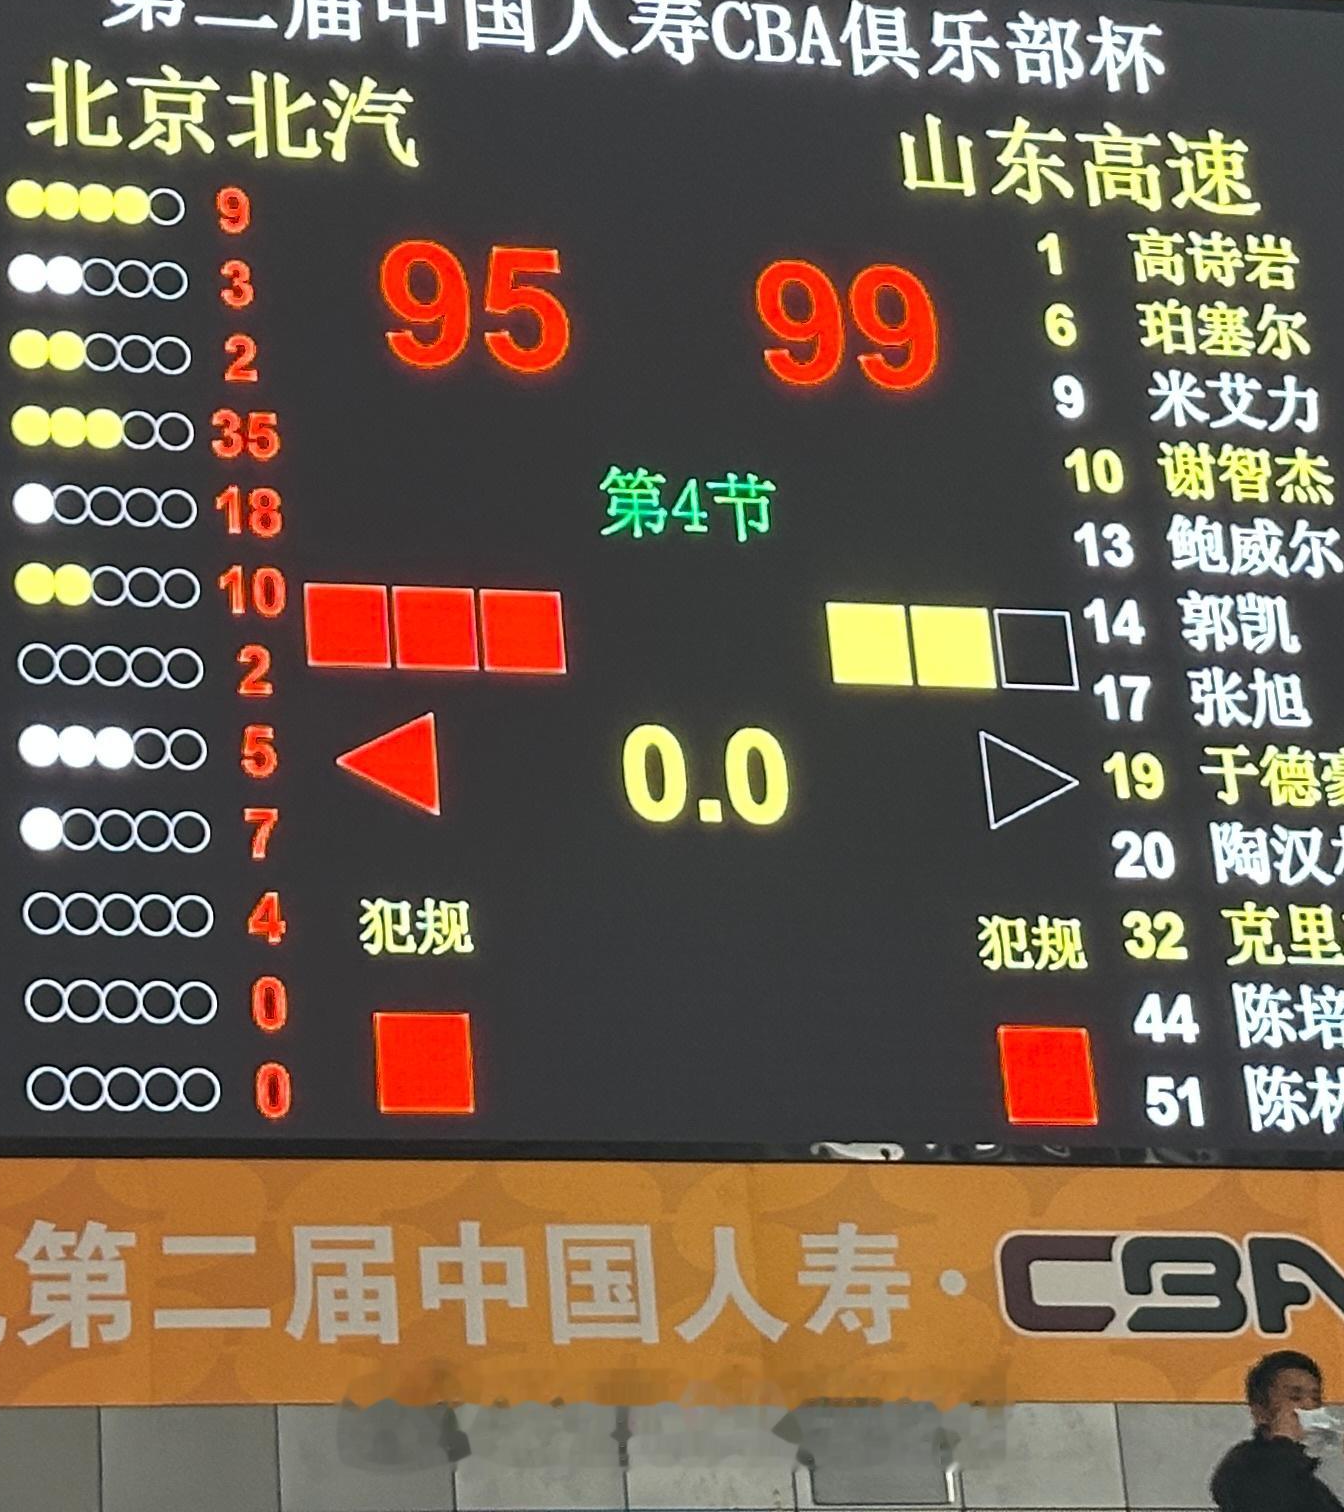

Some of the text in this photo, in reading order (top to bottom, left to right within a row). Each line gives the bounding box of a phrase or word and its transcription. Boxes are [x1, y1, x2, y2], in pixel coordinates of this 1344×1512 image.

[26, 57, 419, 167] 北京北汽
[900, 113, 1261, 216] 山东高速
[216, 186, 250, 234] 9
[220, 260, 254, 310] 3
[1037, 233, 1063, 275] 1
[1128, 227, 1300, 290] 高诗岩
[379, 240, 570, 377] 95
[755, 260, 940, 395] 99
[1045, 303, 1077, 348] 6
[224, 334, 258, 383] 2
[1053, 375, 1087, 421] 9
[1148, 369, 1319, 434] 米艾力
[211, 408, 281, 462] 35
[1065, 448, 1124, 494] 10
[1157, 441, 1334, 505] 谢智杰
[216, 485, 282, 539] 18
[600, 466, 776, 542] 第4节
[1074, 522, 1135, 569] 13
[1166, 514, 1344, 579] 鲍威尔
[218, 565, 286, 619] 10
[1083, 598, 1146, 645] 14
[1177, 590, 1302, 654] 郭凯
[237, 644, 273, 698] 2
[1094, 675, 1152, 722] 17
[1187, 667, 1313, 729] 张旭
[241, 724, 278, 779] 5
[623, 725, 791, 825] 0.0
[1103, 752, 1165, 800] 19
[244, 808, 278, 861] 7
[1112, 830, 1176, 880] 20
[248, 892, 286, 946] 4
[359, 898, 474, 955] 犯规
[978, 915, 1088, 971] 犯规
[1123, 911, 1188, 960] 32
[252, 976, 287, 1033] 0
[1134, 993, 1200, 1044] 44
[256, 1062, 291, 1121] 0
[1146, 1076, 1205, 1127] 51
